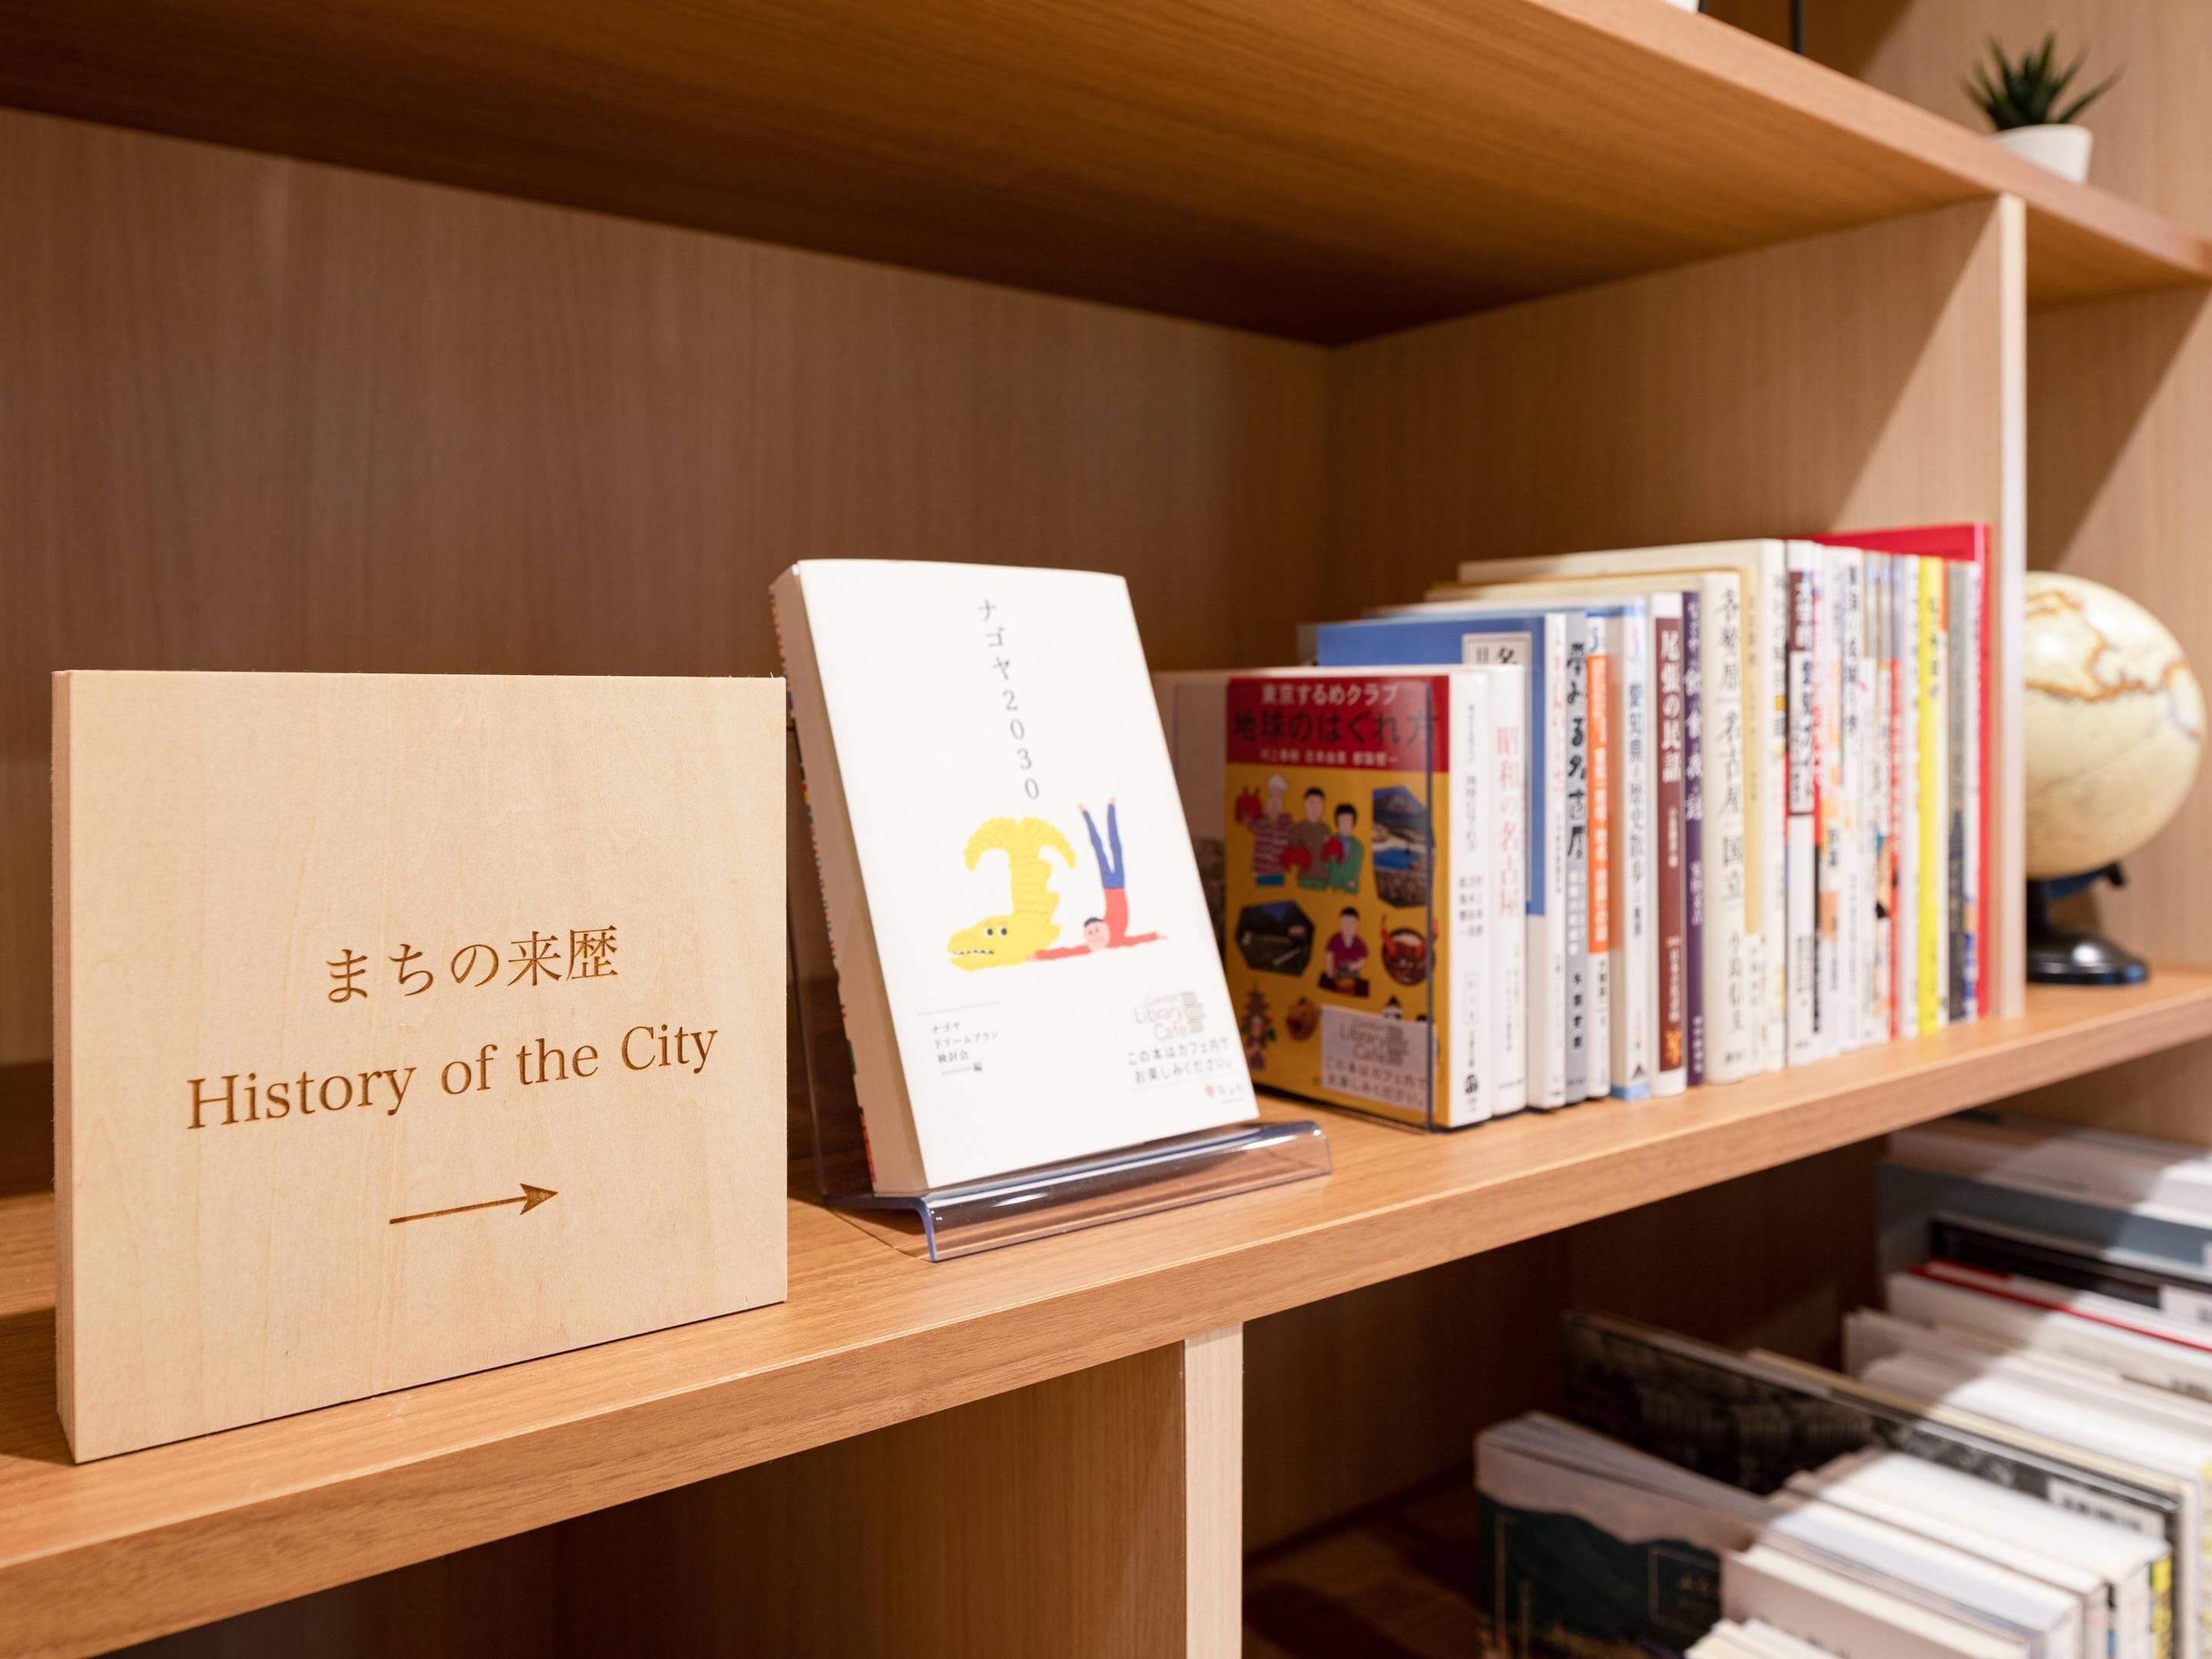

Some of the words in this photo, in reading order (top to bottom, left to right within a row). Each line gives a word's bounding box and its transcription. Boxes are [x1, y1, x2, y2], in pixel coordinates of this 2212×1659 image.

[978, 599, 1039, 800] ナゴヤ2030
[1233, 709, 1439, 746] 地球のはぐれ方
[1260, 683, 1400, 706] 東京するめクラブ
[1661, 629, 1681, 783] 尾張の民話
[325, 925, 619, 1004] まちの来歴
[1133, 1005, 1183, 1025] Library
[186, 1065, 417, 1130] History
[440, 1044, 498, 1094] of
[516, 1038, 599, 1085] the
[621, 1023, 719, 1075] City
